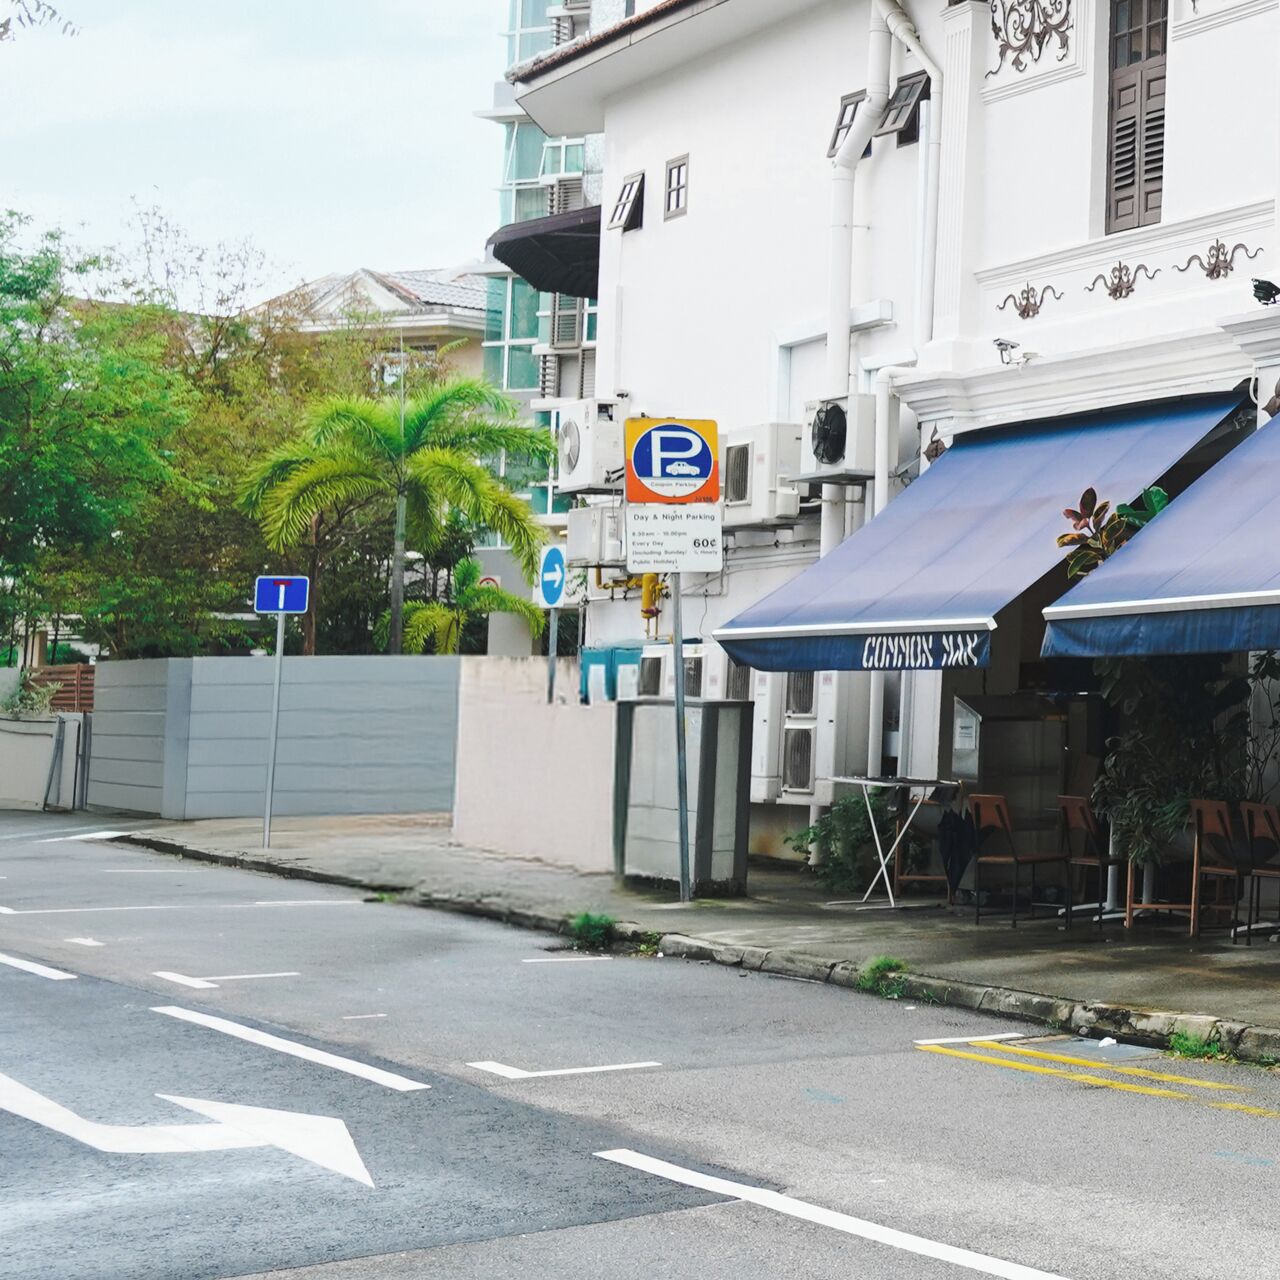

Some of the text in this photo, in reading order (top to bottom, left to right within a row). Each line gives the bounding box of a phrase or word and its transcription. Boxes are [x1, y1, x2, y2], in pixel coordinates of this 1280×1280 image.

[651, 430, 703, 477] P
[633, 513, 649, 521] Day
[662, 513, 683, 521] Night
[686, 513, 715, 521] Parking
[862, 633, 978, 668] COMMON MAN
